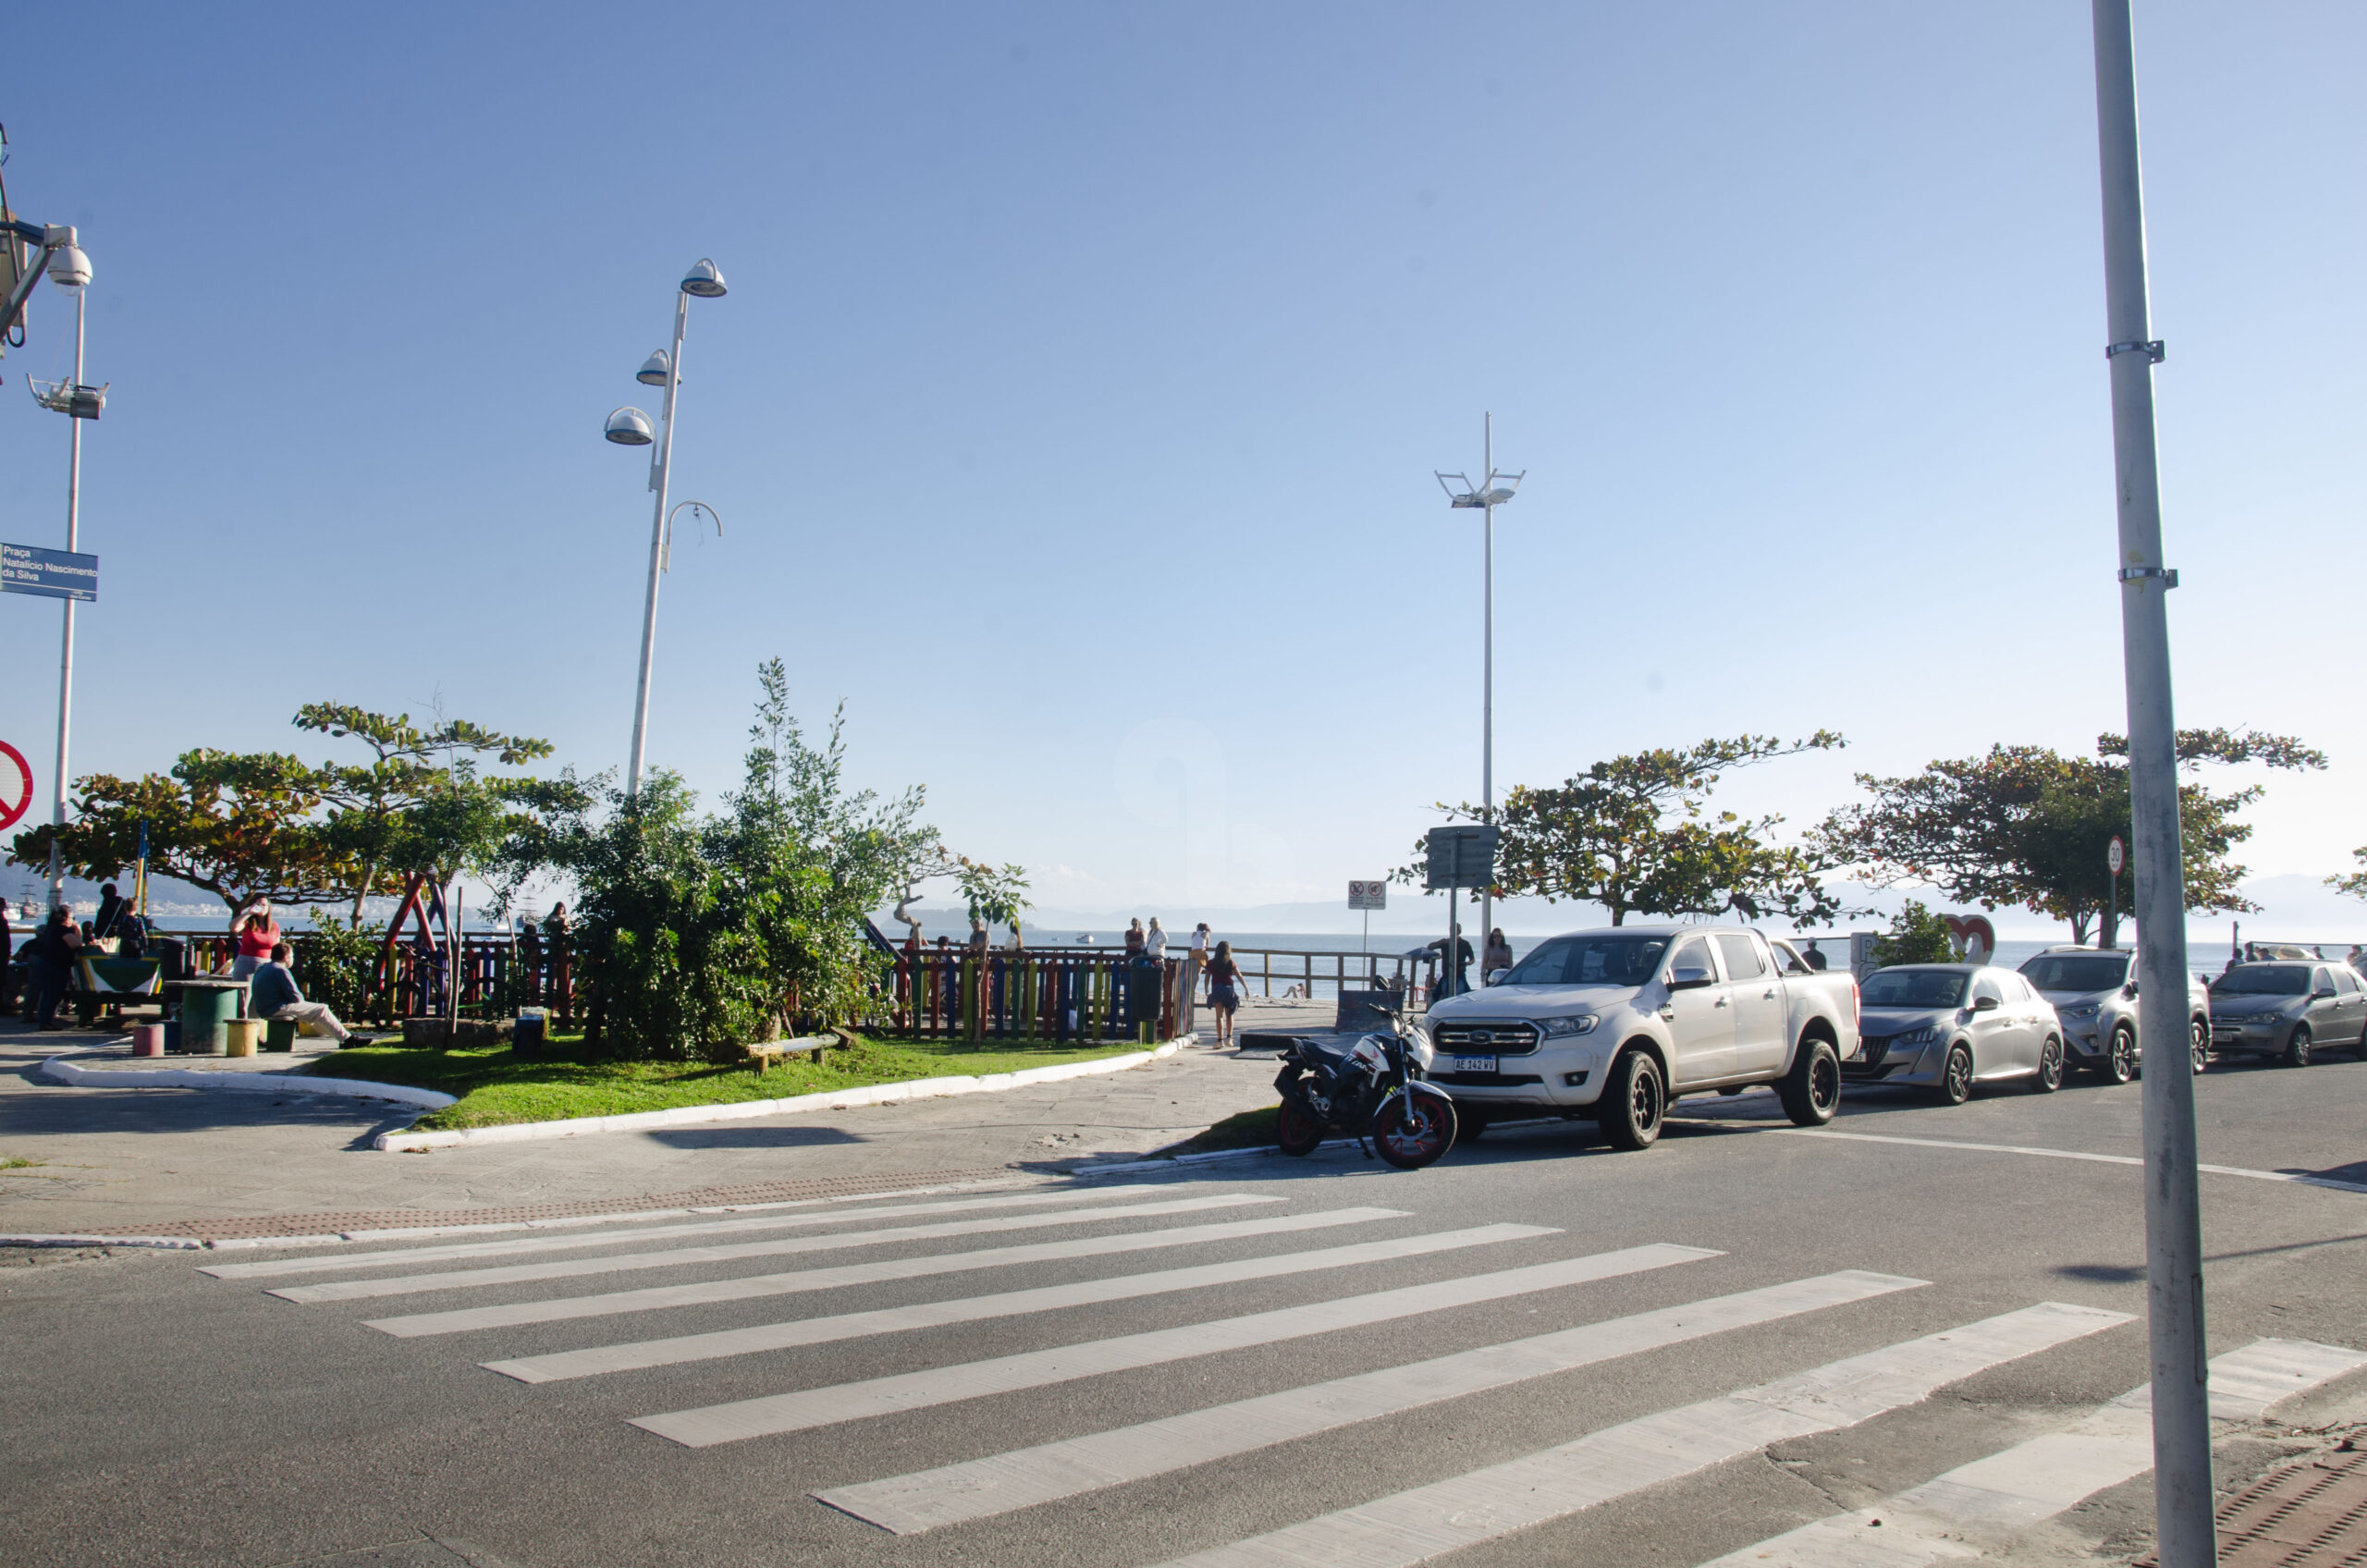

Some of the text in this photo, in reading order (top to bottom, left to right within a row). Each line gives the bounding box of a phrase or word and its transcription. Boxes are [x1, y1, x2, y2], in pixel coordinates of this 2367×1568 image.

[4, 545, 31, 558] Praça
[2, 569, 40, 582] da Silva
[44, 563, 98, 577] Nascimento
[2111, 847, 2119, 862] 30
